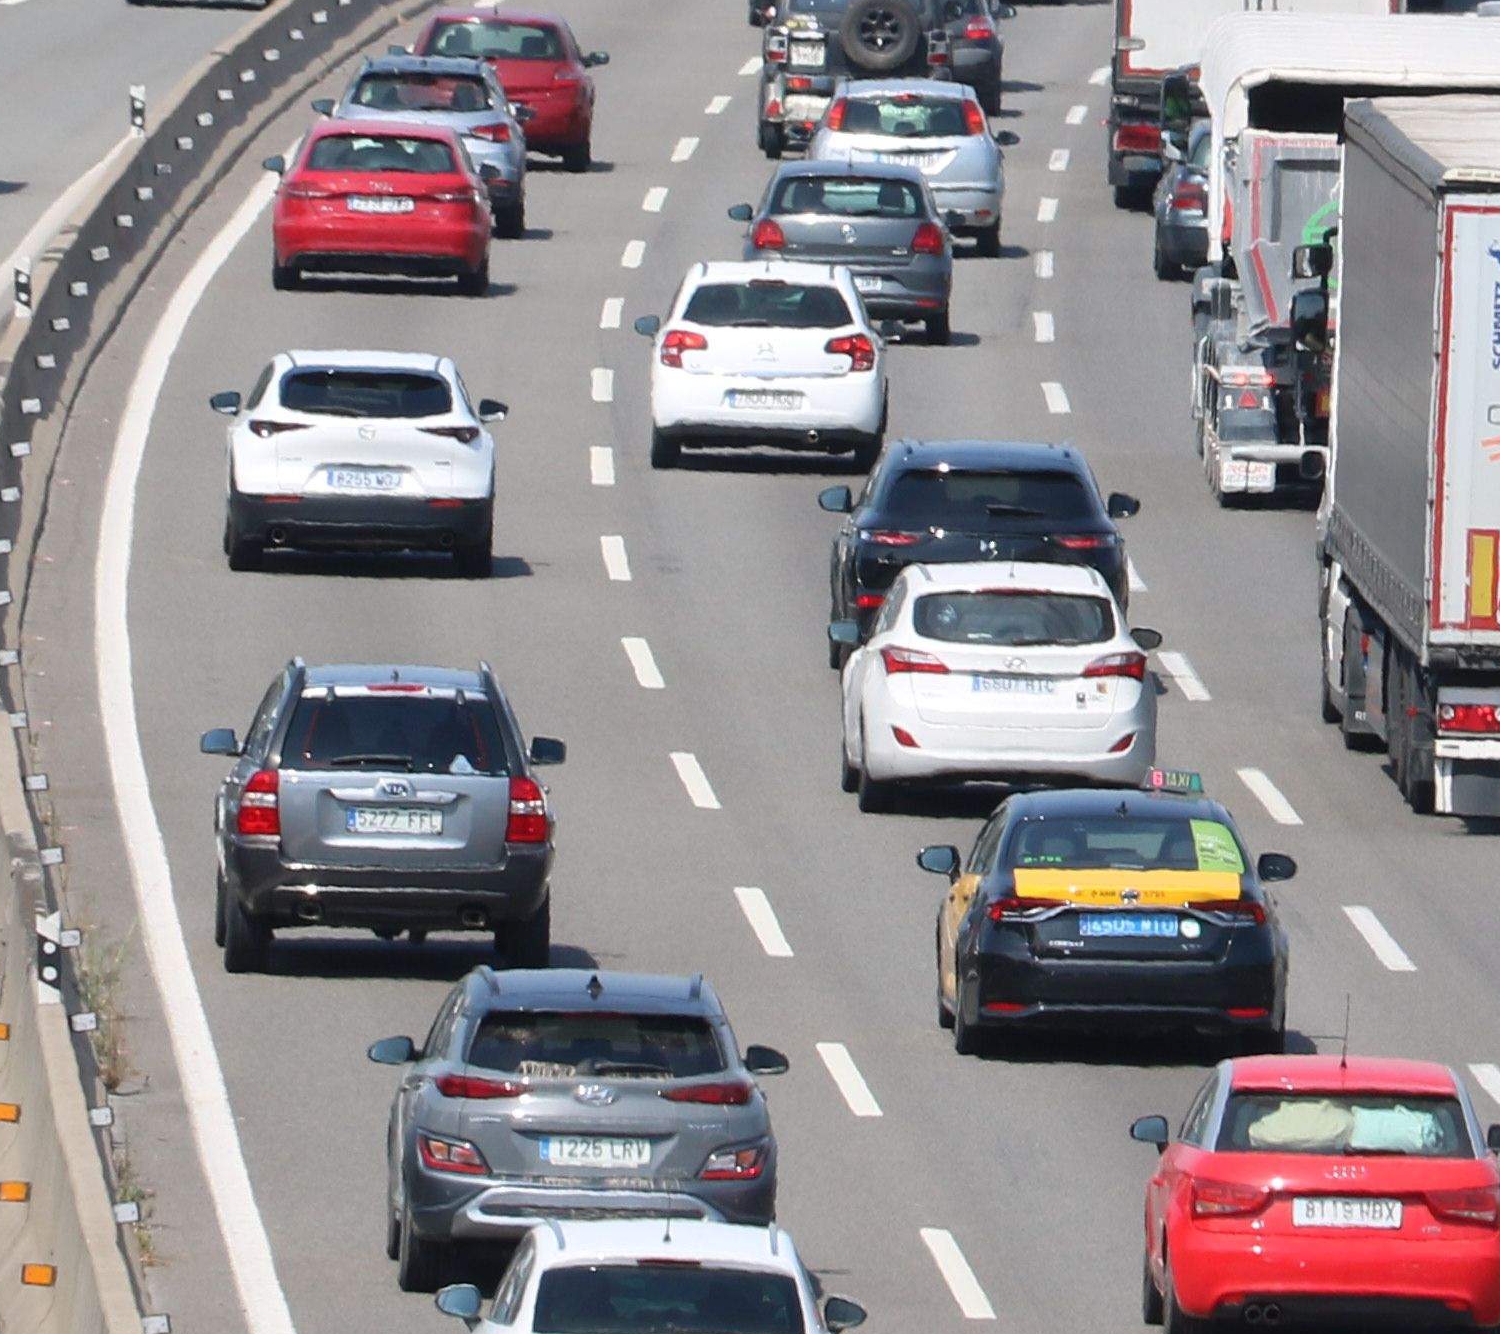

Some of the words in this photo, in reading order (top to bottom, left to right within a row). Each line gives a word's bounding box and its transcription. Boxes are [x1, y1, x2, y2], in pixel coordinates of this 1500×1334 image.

[357, 808, 402, 828] 5277
[407, 809, 440, 829] FFL
[610, 1139, 647, 1160] LRV
